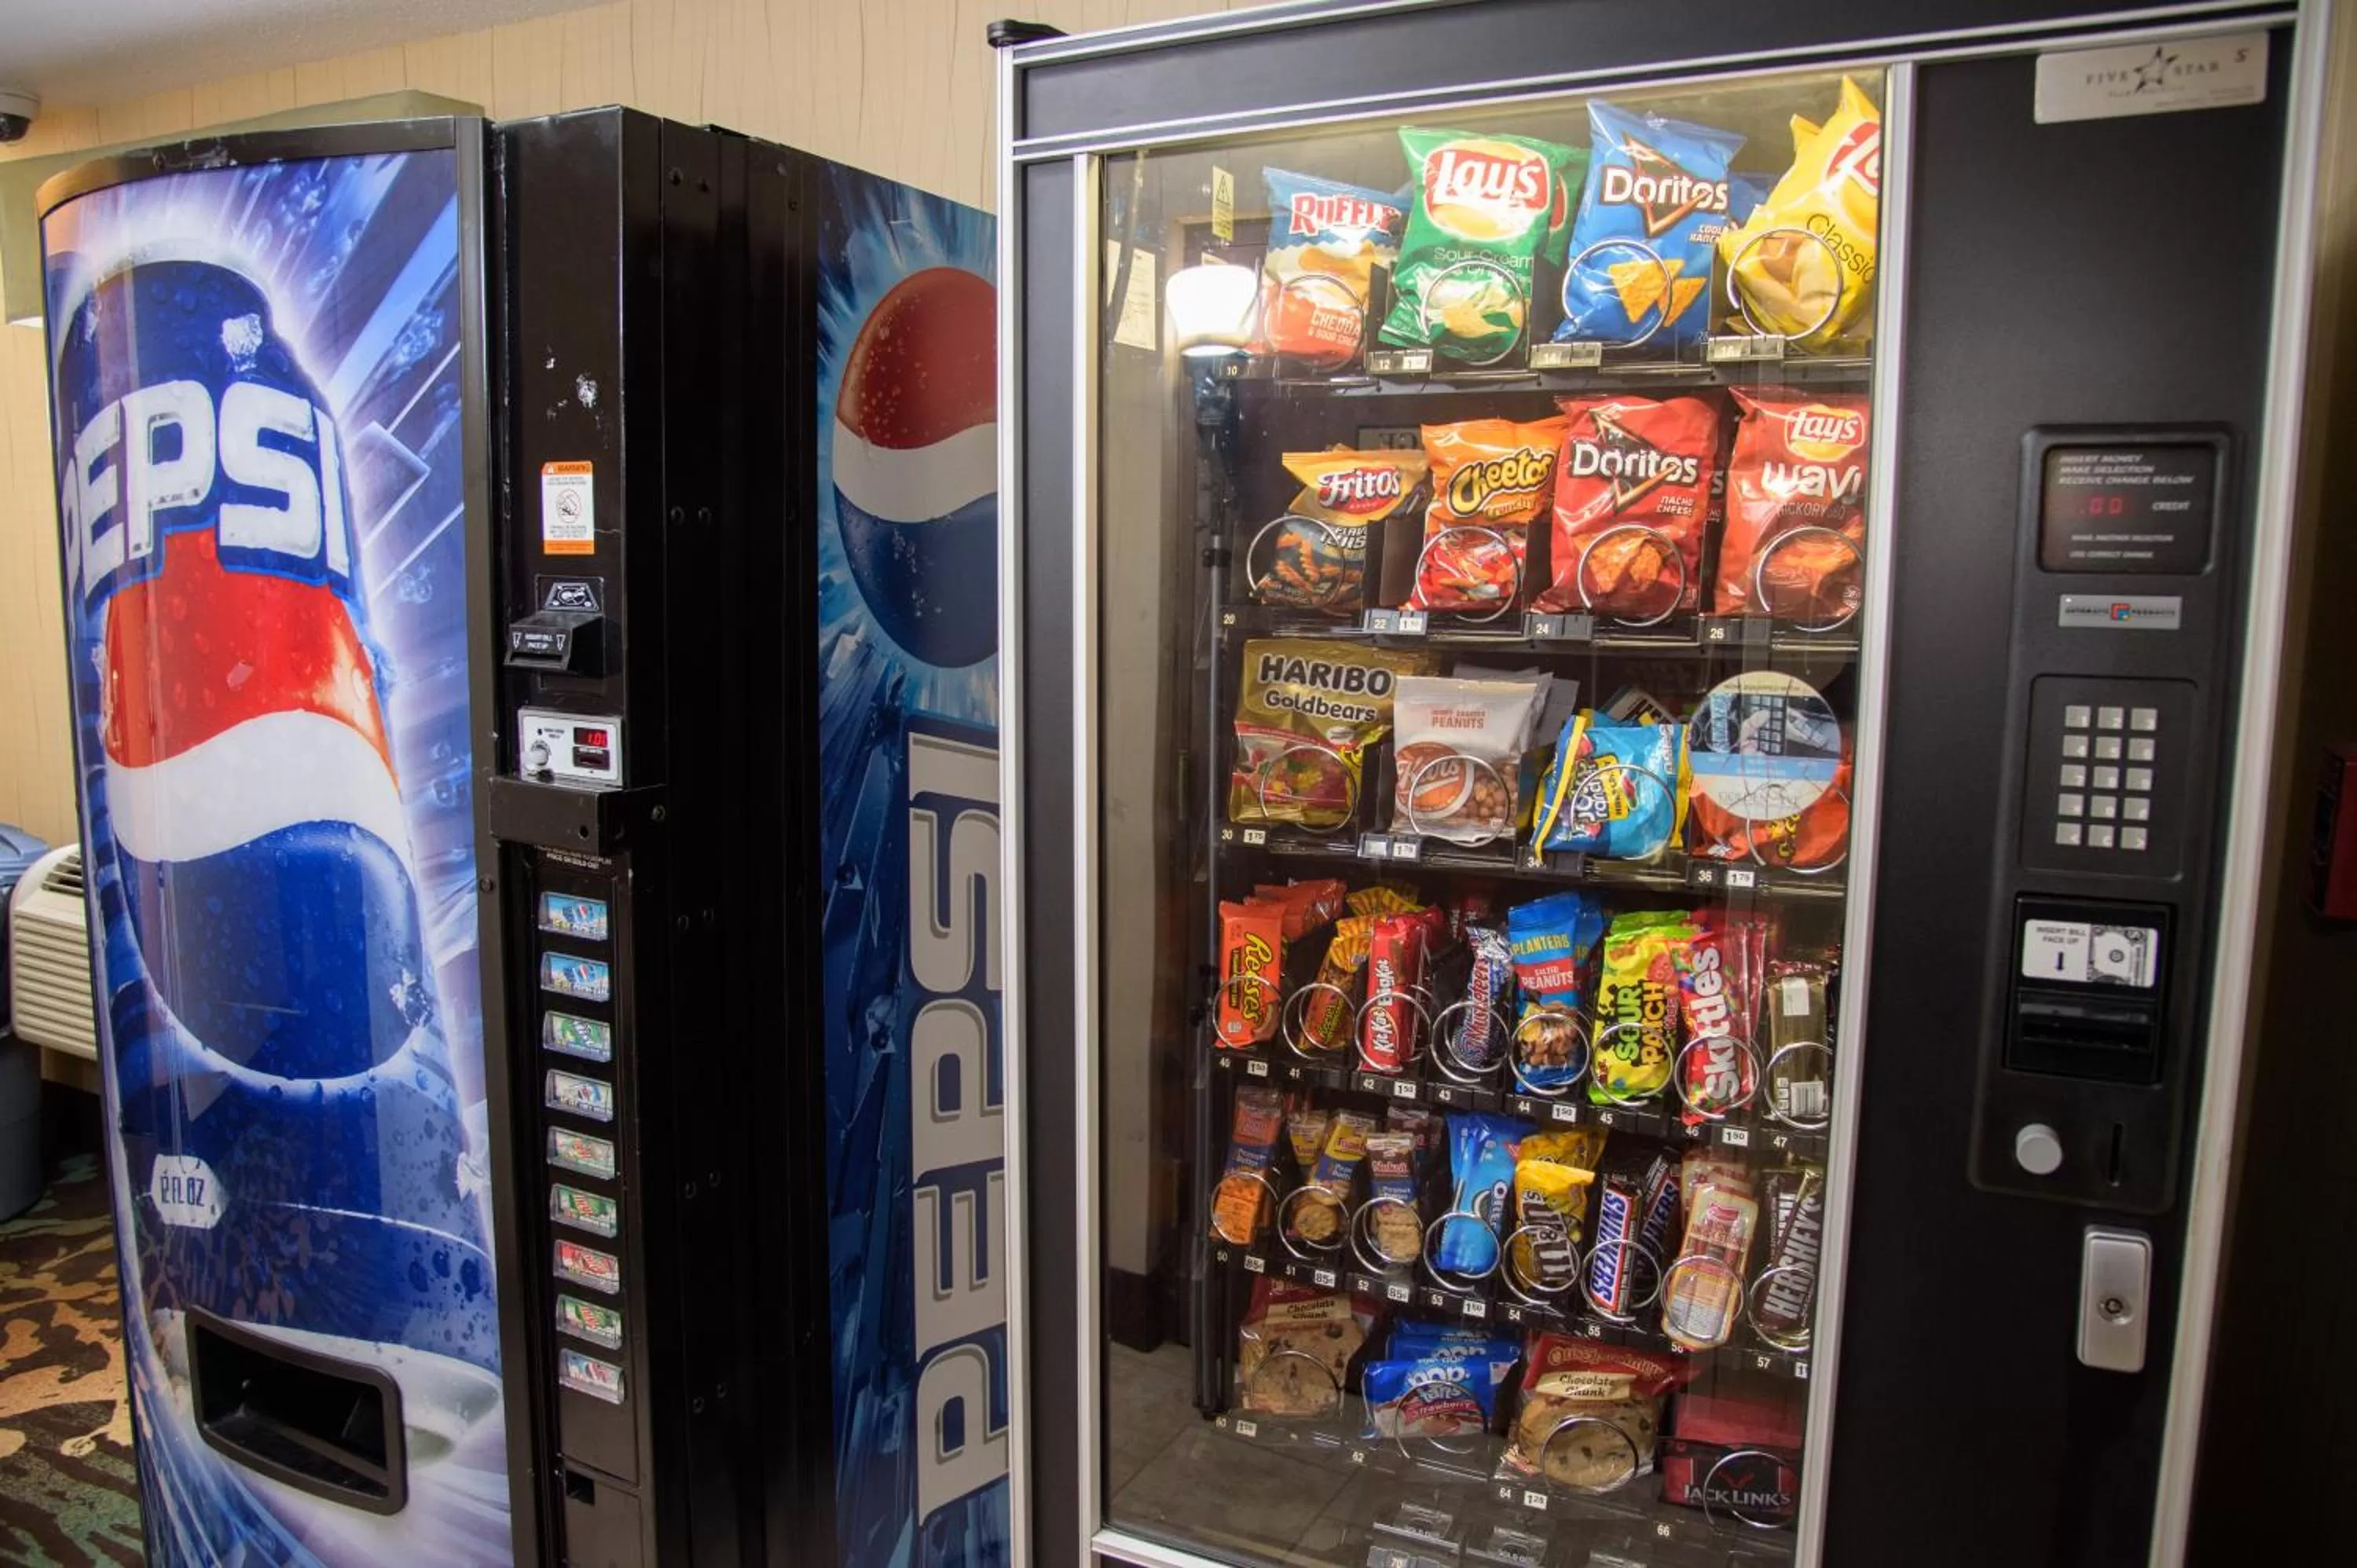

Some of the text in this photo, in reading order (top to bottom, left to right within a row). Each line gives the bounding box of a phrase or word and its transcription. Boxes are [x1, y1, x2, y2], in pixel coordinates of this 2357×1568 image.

[2086, 71, 2128, 85] FIVE
[2174, 62, 2220, 76] STAR
[1435, 151, 1542, 209] Lay's
[1604, 167, 1728, 211] Doritos
[1807, 213, 1876, 284] Classic
[1310, 310, 1362, 337] CHEDDA
[1790, 411, 1860, 443] Lay's
[1573, 441, 1698, 484] Doritos
[2100, 454, 2144, 463] MONEY
[60, 379, 350, 609] PEPSI
[1317, 468, 1401, 507] Fritos
[1222, 613, 1237, 625] 20
[1373, 617, 1387, 630] 22
[1535, 623, 1549, 636] 24
[1710, 628, 1725, 639] 26
[1259, 654, 1394, 698] HARIBO
[1265, 690, 1376, 723] Goldbears
[1431, 716, 1484, 730] PEANUTS
[1222, 829, 1233, 841] 30
[1511, 932, 1571, 955] PLANTERS
[1521, 970, 1574, 989] PEANUTS
[1615, 986, 1642, 1061] SOUR
[1640, 981, 1666, 1066] PATCH
[1363, 1079, 1375, 1090] 42
[1439, 1090, 1451, 1101] 43
[1517, 1101, 1530, 1113] 44
[1600, 1112, 1614, 1125] 45
[907, 731, 1010, 1528] PEPSI
[1685, 1126, 1699, 1138] 46
[1773, 1136, 1787, 1149] 47
[187, 1177, 206, 1207] OZ
[1589, 1189, 1627, 1302] SNICKERS
[1764, 1196, 1823, 1321] HERSHEY'S
[1358, 1279, 1370, 1291] 52
[1431, 1295, 1443, 1306] 53
[1508, 1309, 1521, 1321] 54
[1588, 1325, 1601, 1338] 55
[1758, 1356, 1771, 1369] 57
[1559, 1374, 1617, 1387] Chocolate
[1499, 1487, 1512, 1500] 64
[1684, 1483, 1729, 1507] JACK
[1657, 1524, 1670, 1537] 66
